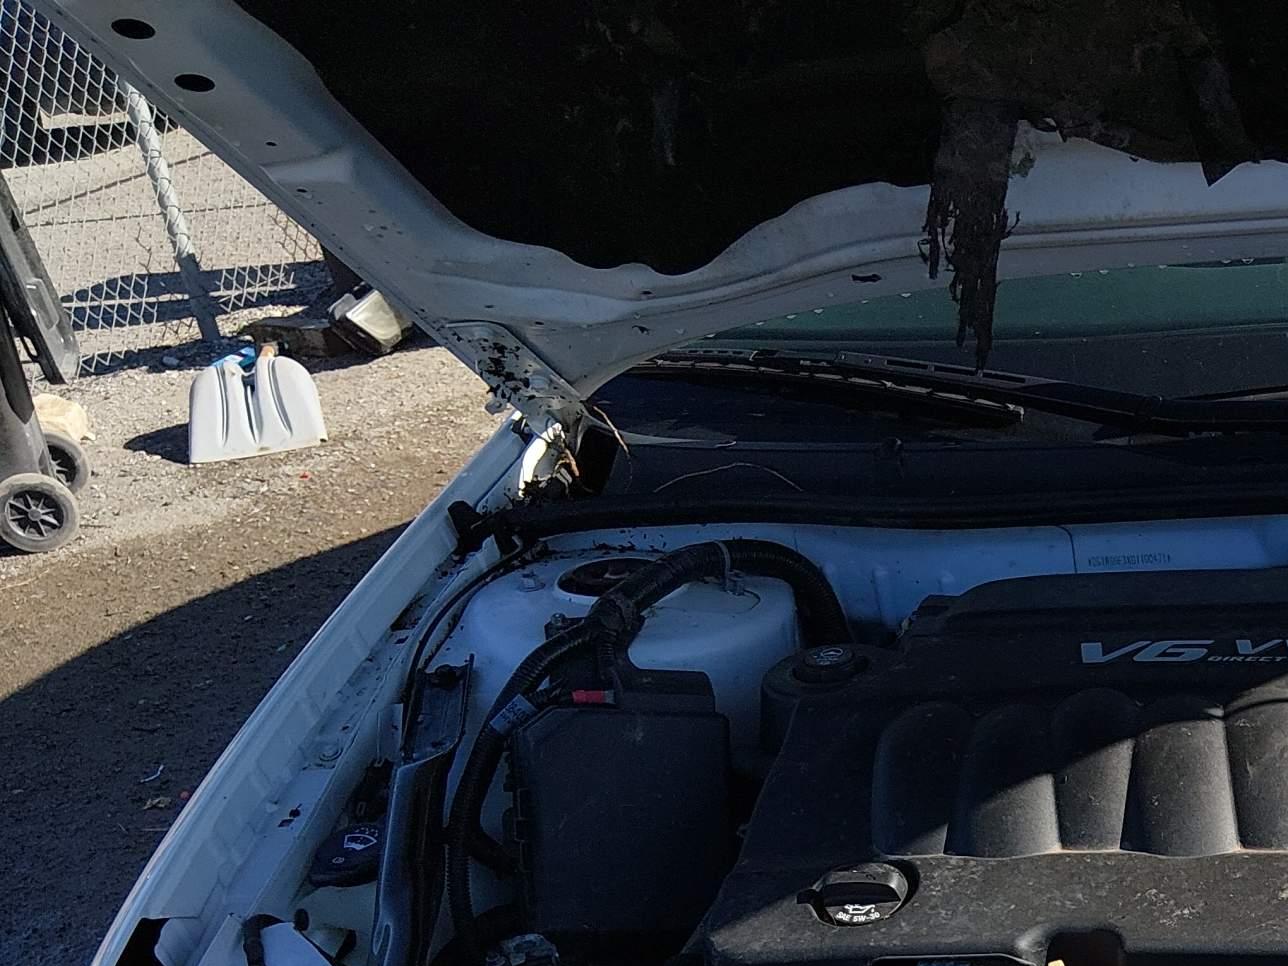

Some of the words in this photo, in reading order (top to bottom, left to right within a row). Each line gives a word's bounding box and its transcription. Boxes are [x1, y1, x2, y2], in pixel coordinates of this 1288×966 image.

[1080, 640, 1215, 663] V6
[835, 911, 852, 922] SAE
[852, 911, 881, 922] 5W-30
